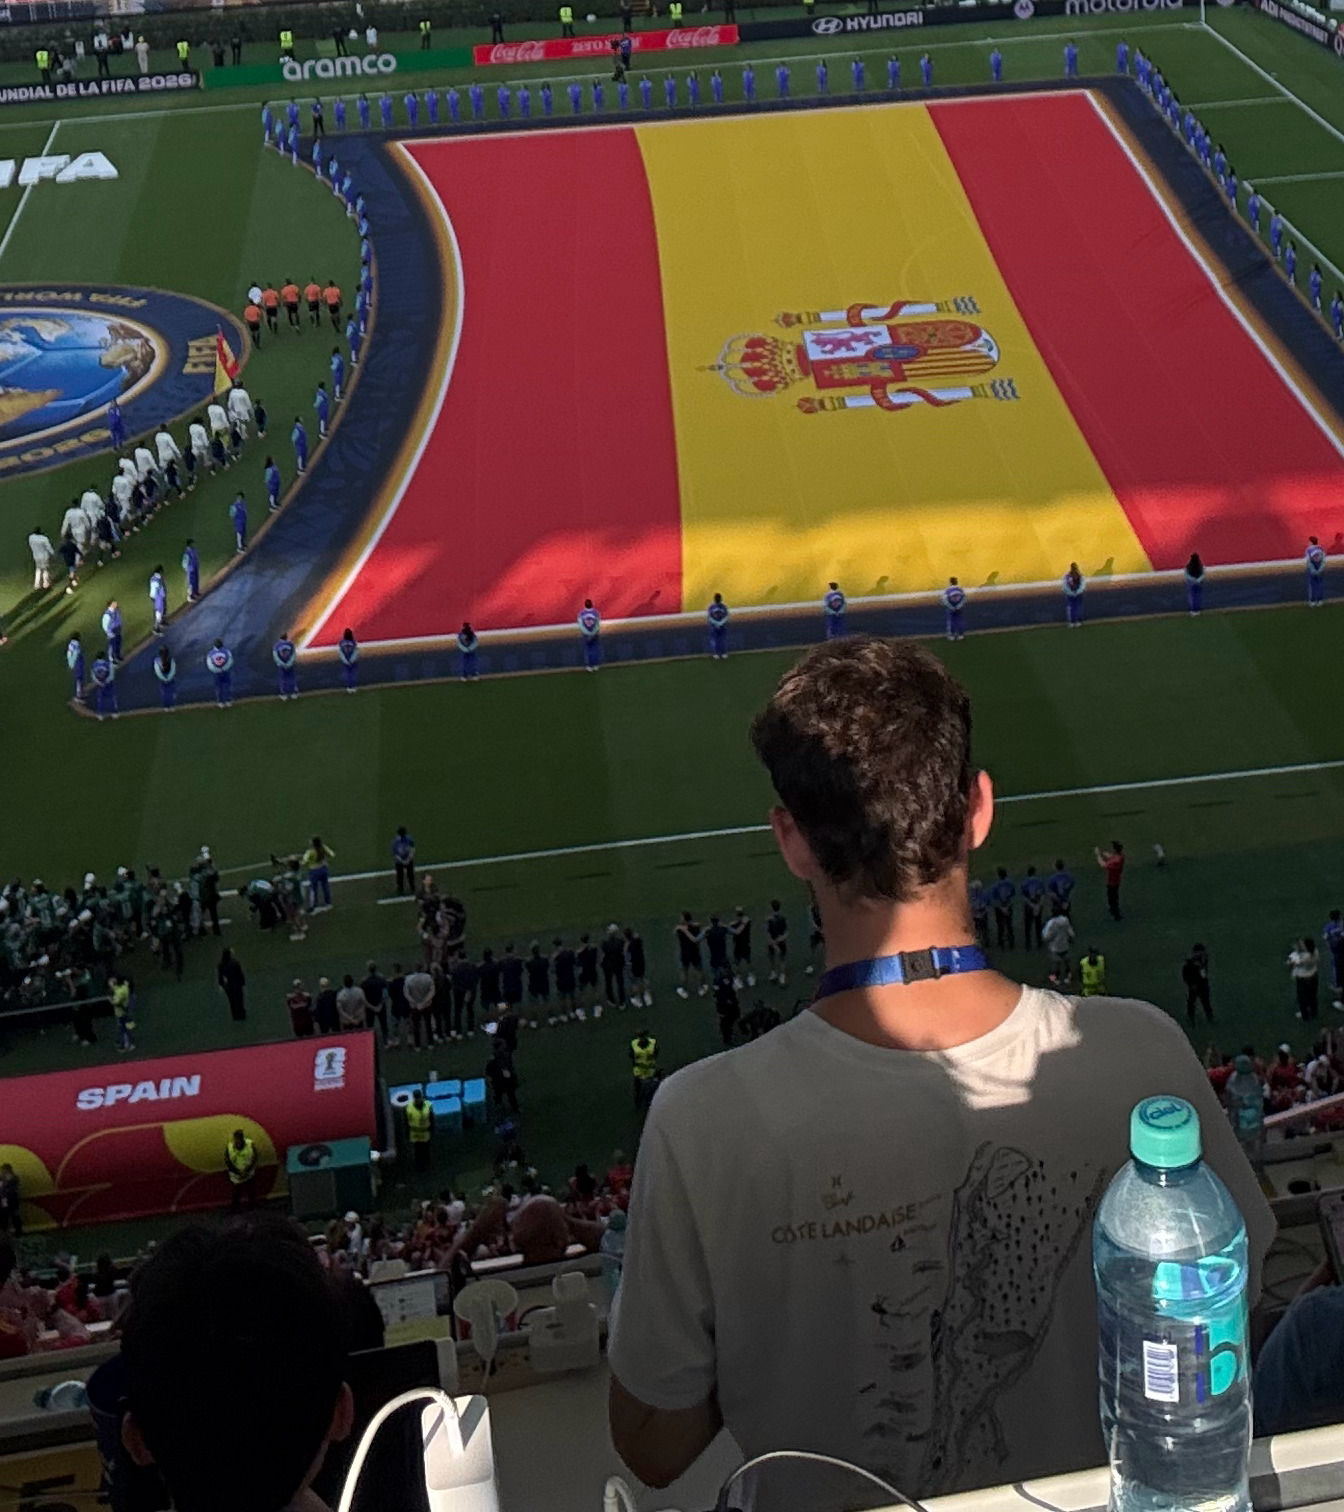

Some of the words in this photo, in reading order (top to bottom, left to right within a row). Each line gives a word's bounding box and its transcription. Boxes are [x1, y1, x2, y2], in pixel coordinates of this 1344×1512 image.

[846, 11, 924, 32] HYUNDAI
[282, 53, 397, 81] aramco
[56, 82, 77, 97] DE
[79, 80, 100, 95] LA
[101, 77, 136, 94] FIFA
[75, 1074, 201, 1111] SPAIN
